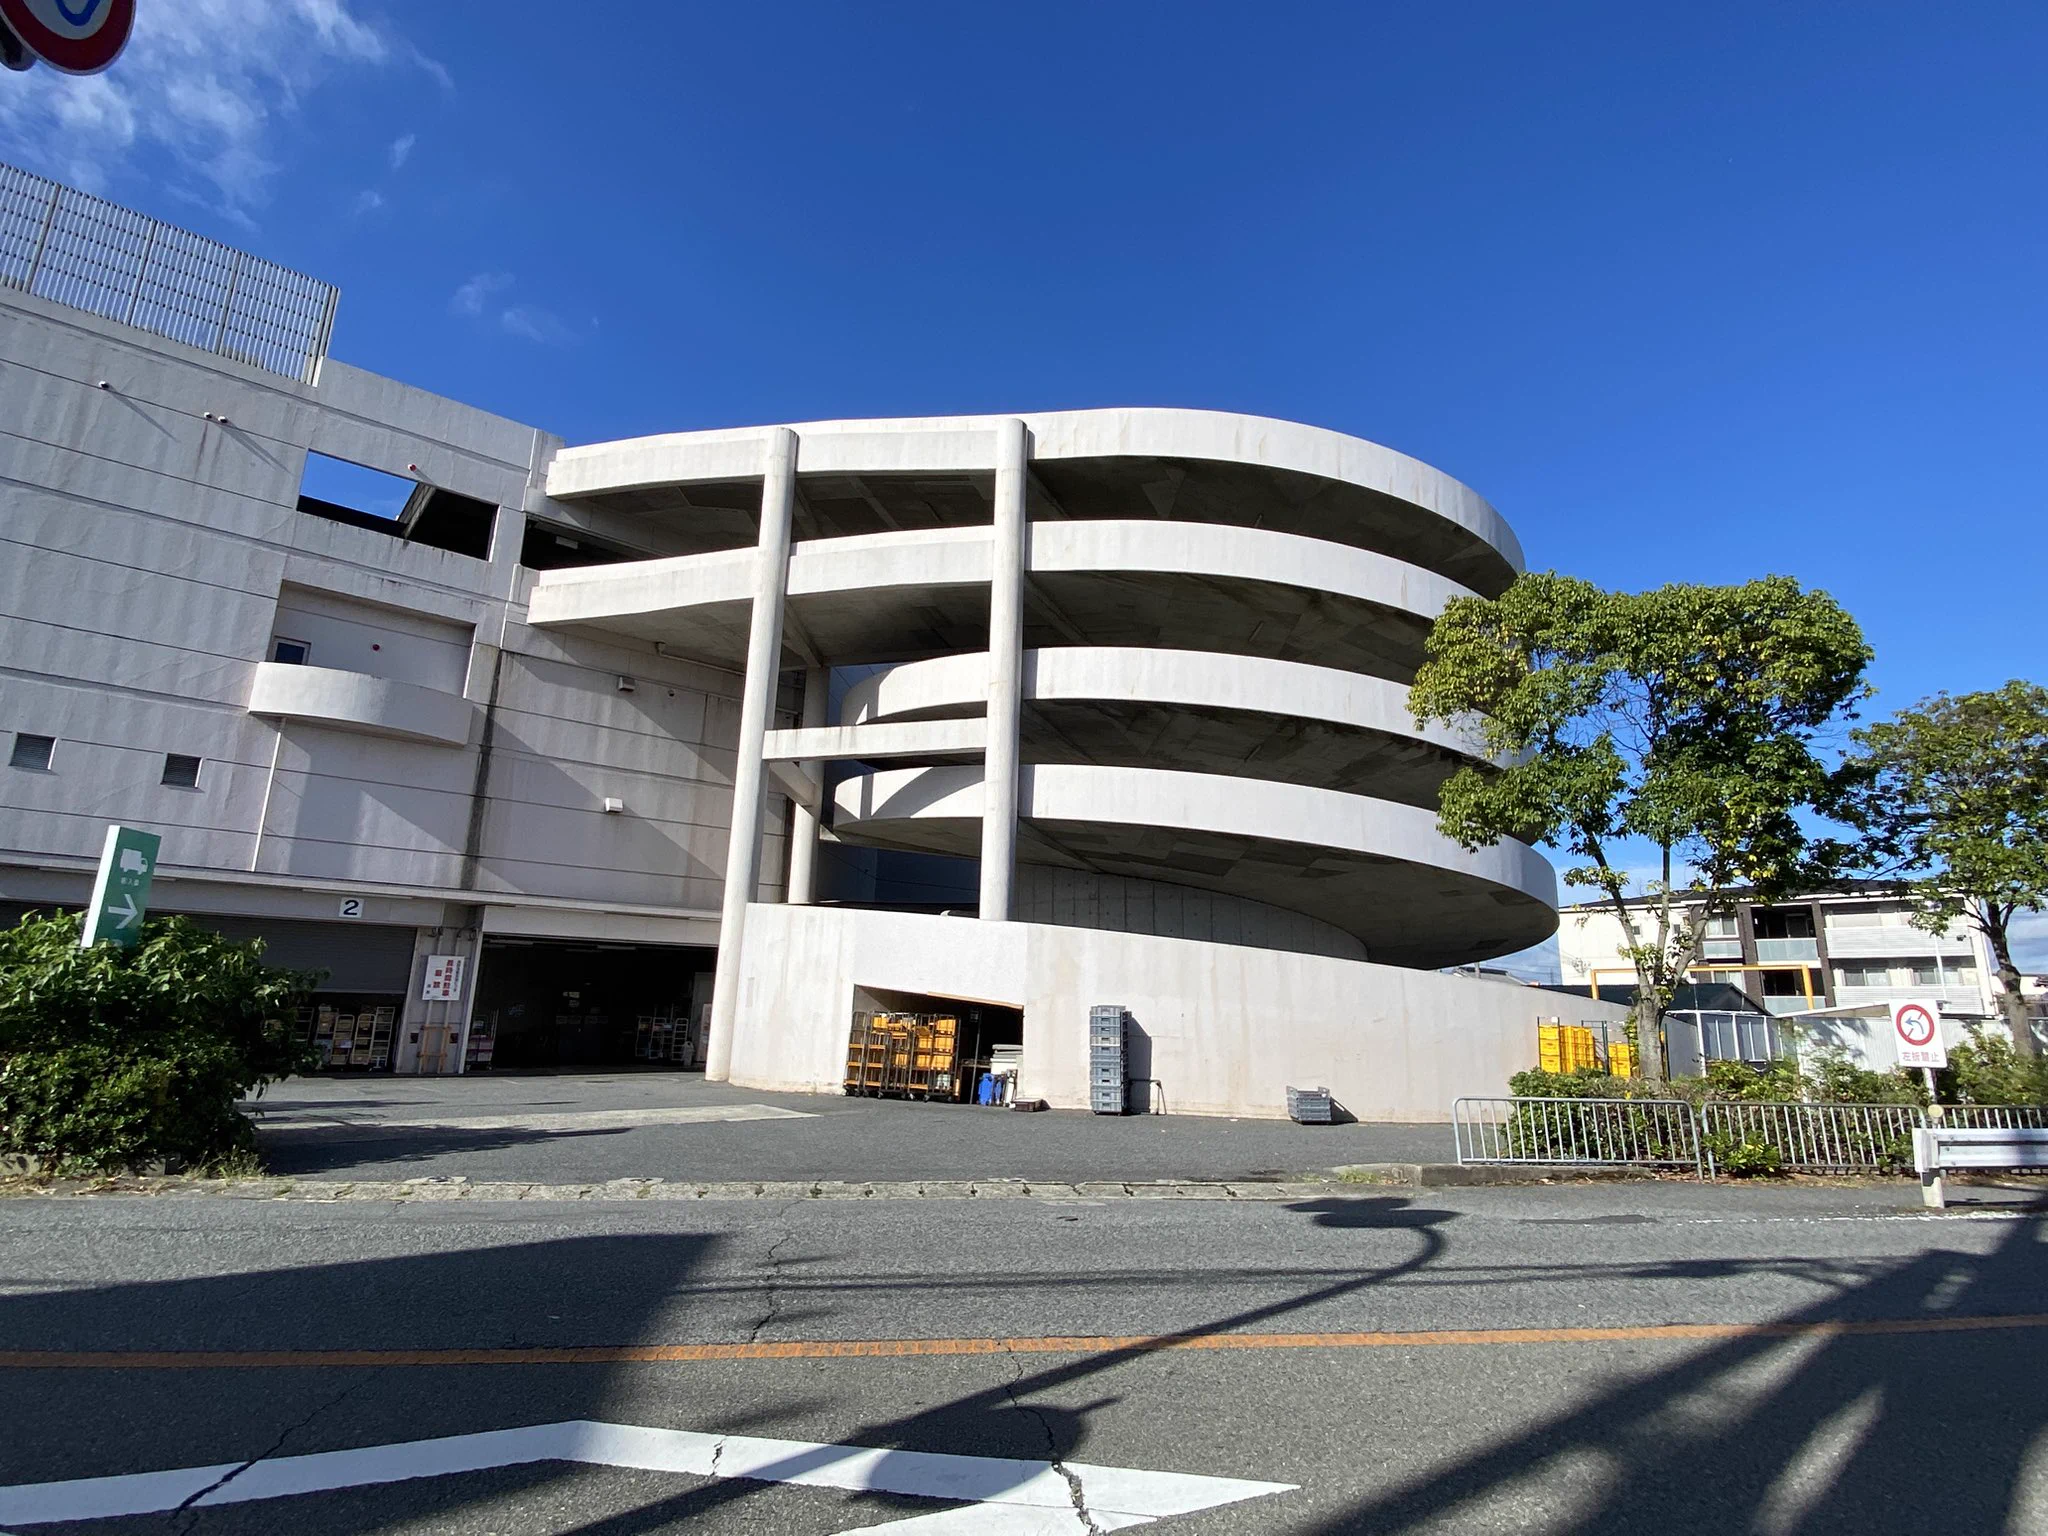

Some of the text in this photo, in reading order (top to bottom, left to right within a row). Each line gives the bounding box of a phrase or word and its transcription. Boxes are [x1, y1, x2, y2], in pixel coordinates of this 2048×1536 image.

[343, 899, 359, 915] 2
[1901, 1051, 1940, 1063] 左折禁止
